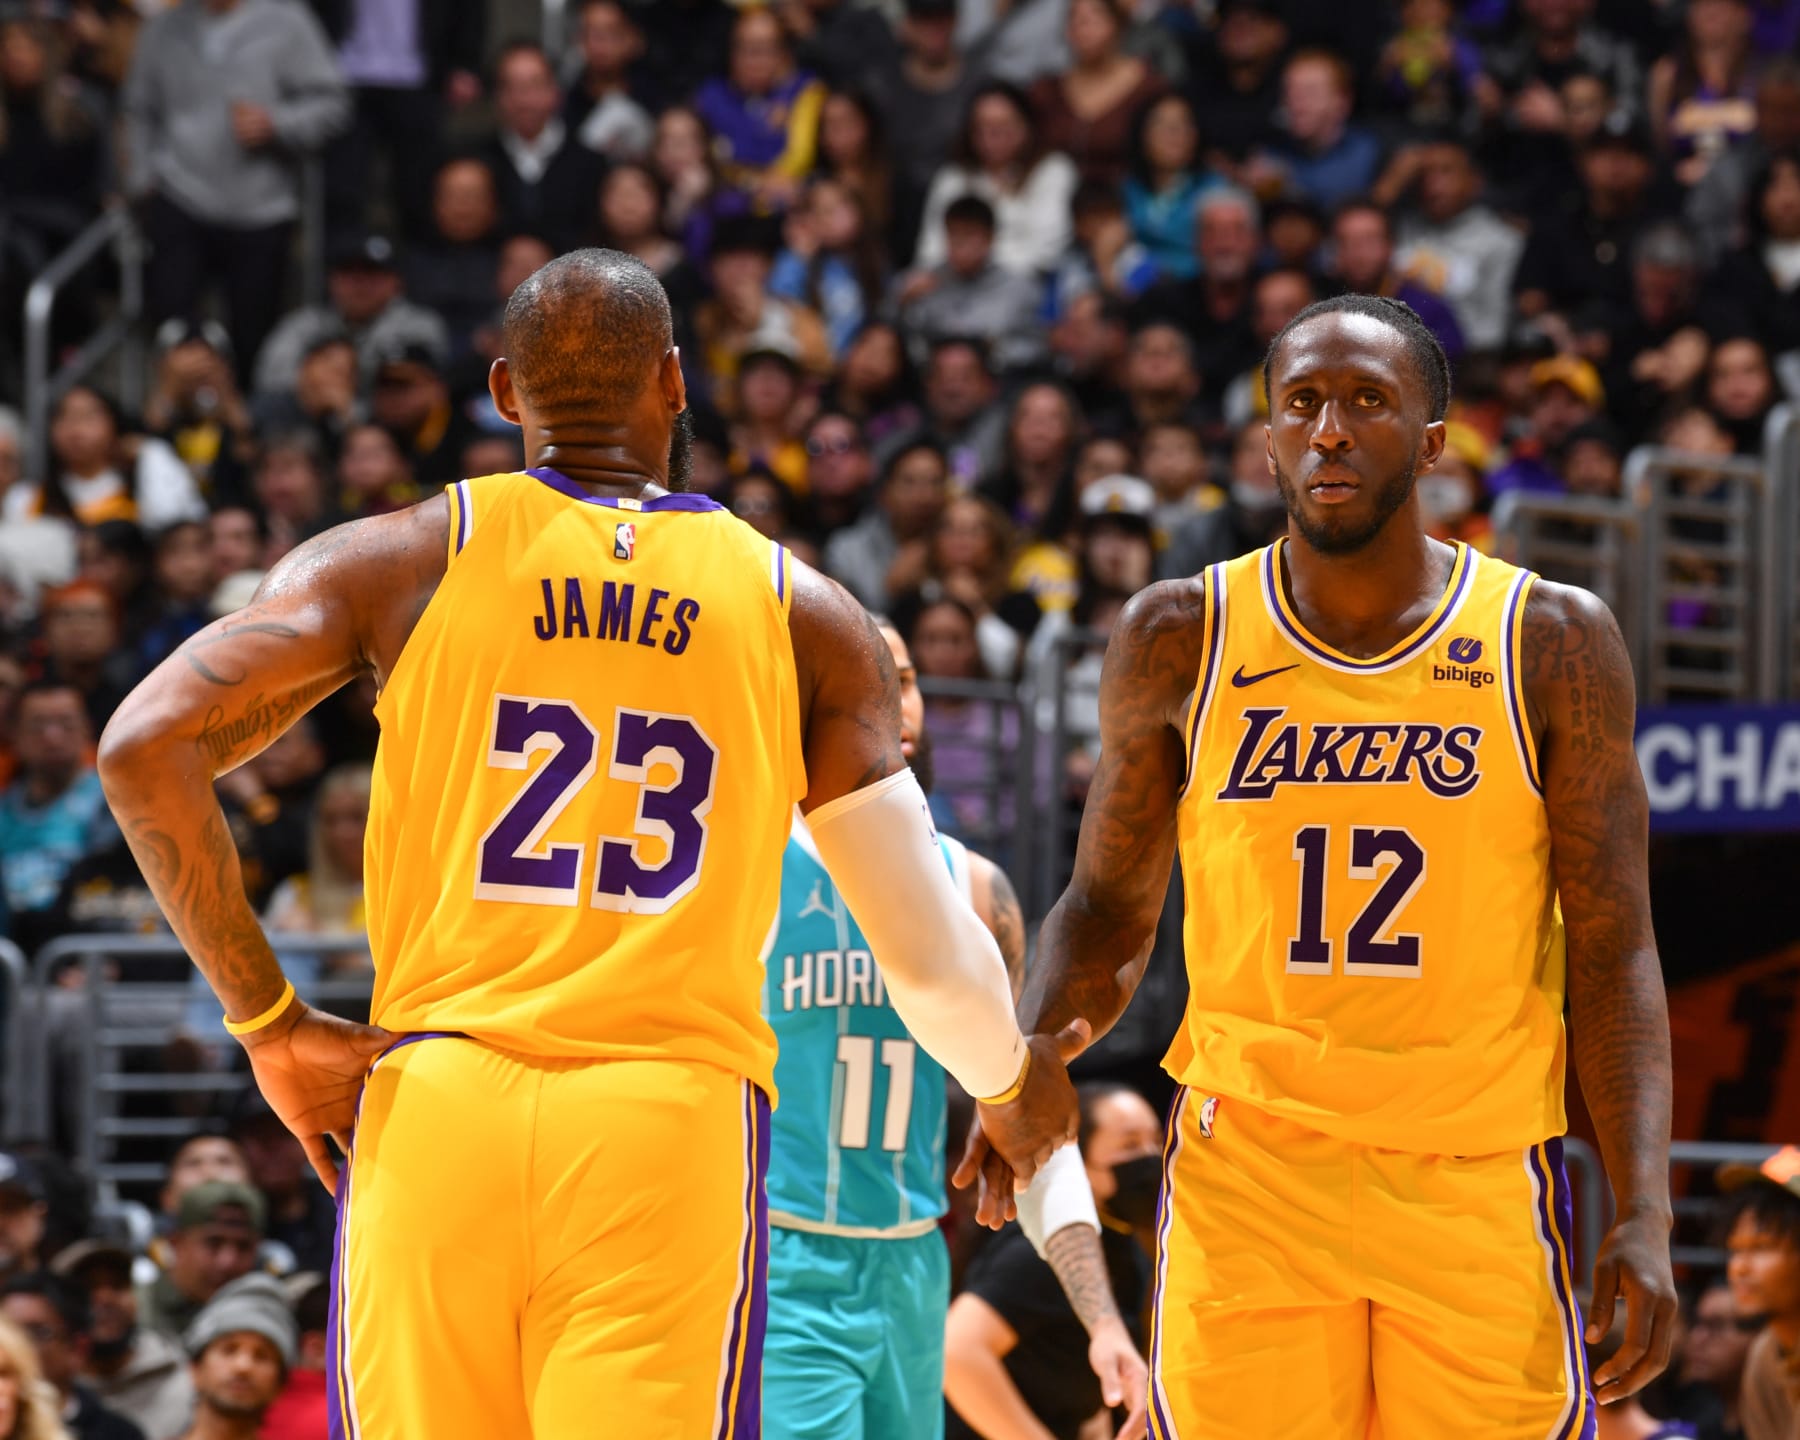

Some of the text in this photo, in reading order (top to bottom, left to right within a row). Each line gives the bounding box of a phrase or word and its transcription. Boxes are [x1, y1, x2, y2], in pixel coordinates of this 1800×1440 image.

[533, 577, 700, 656] JAMES
[1433, 665, 1494, 688] bibigo
[1214, 706, 1485, 803] LAKERS
[1634, 722, 1800, 812] CHA
[473, 692, 720, 915] 23
[1285, 823, 1428, 979] 12
[836, 1034, 916, 1153] 11
